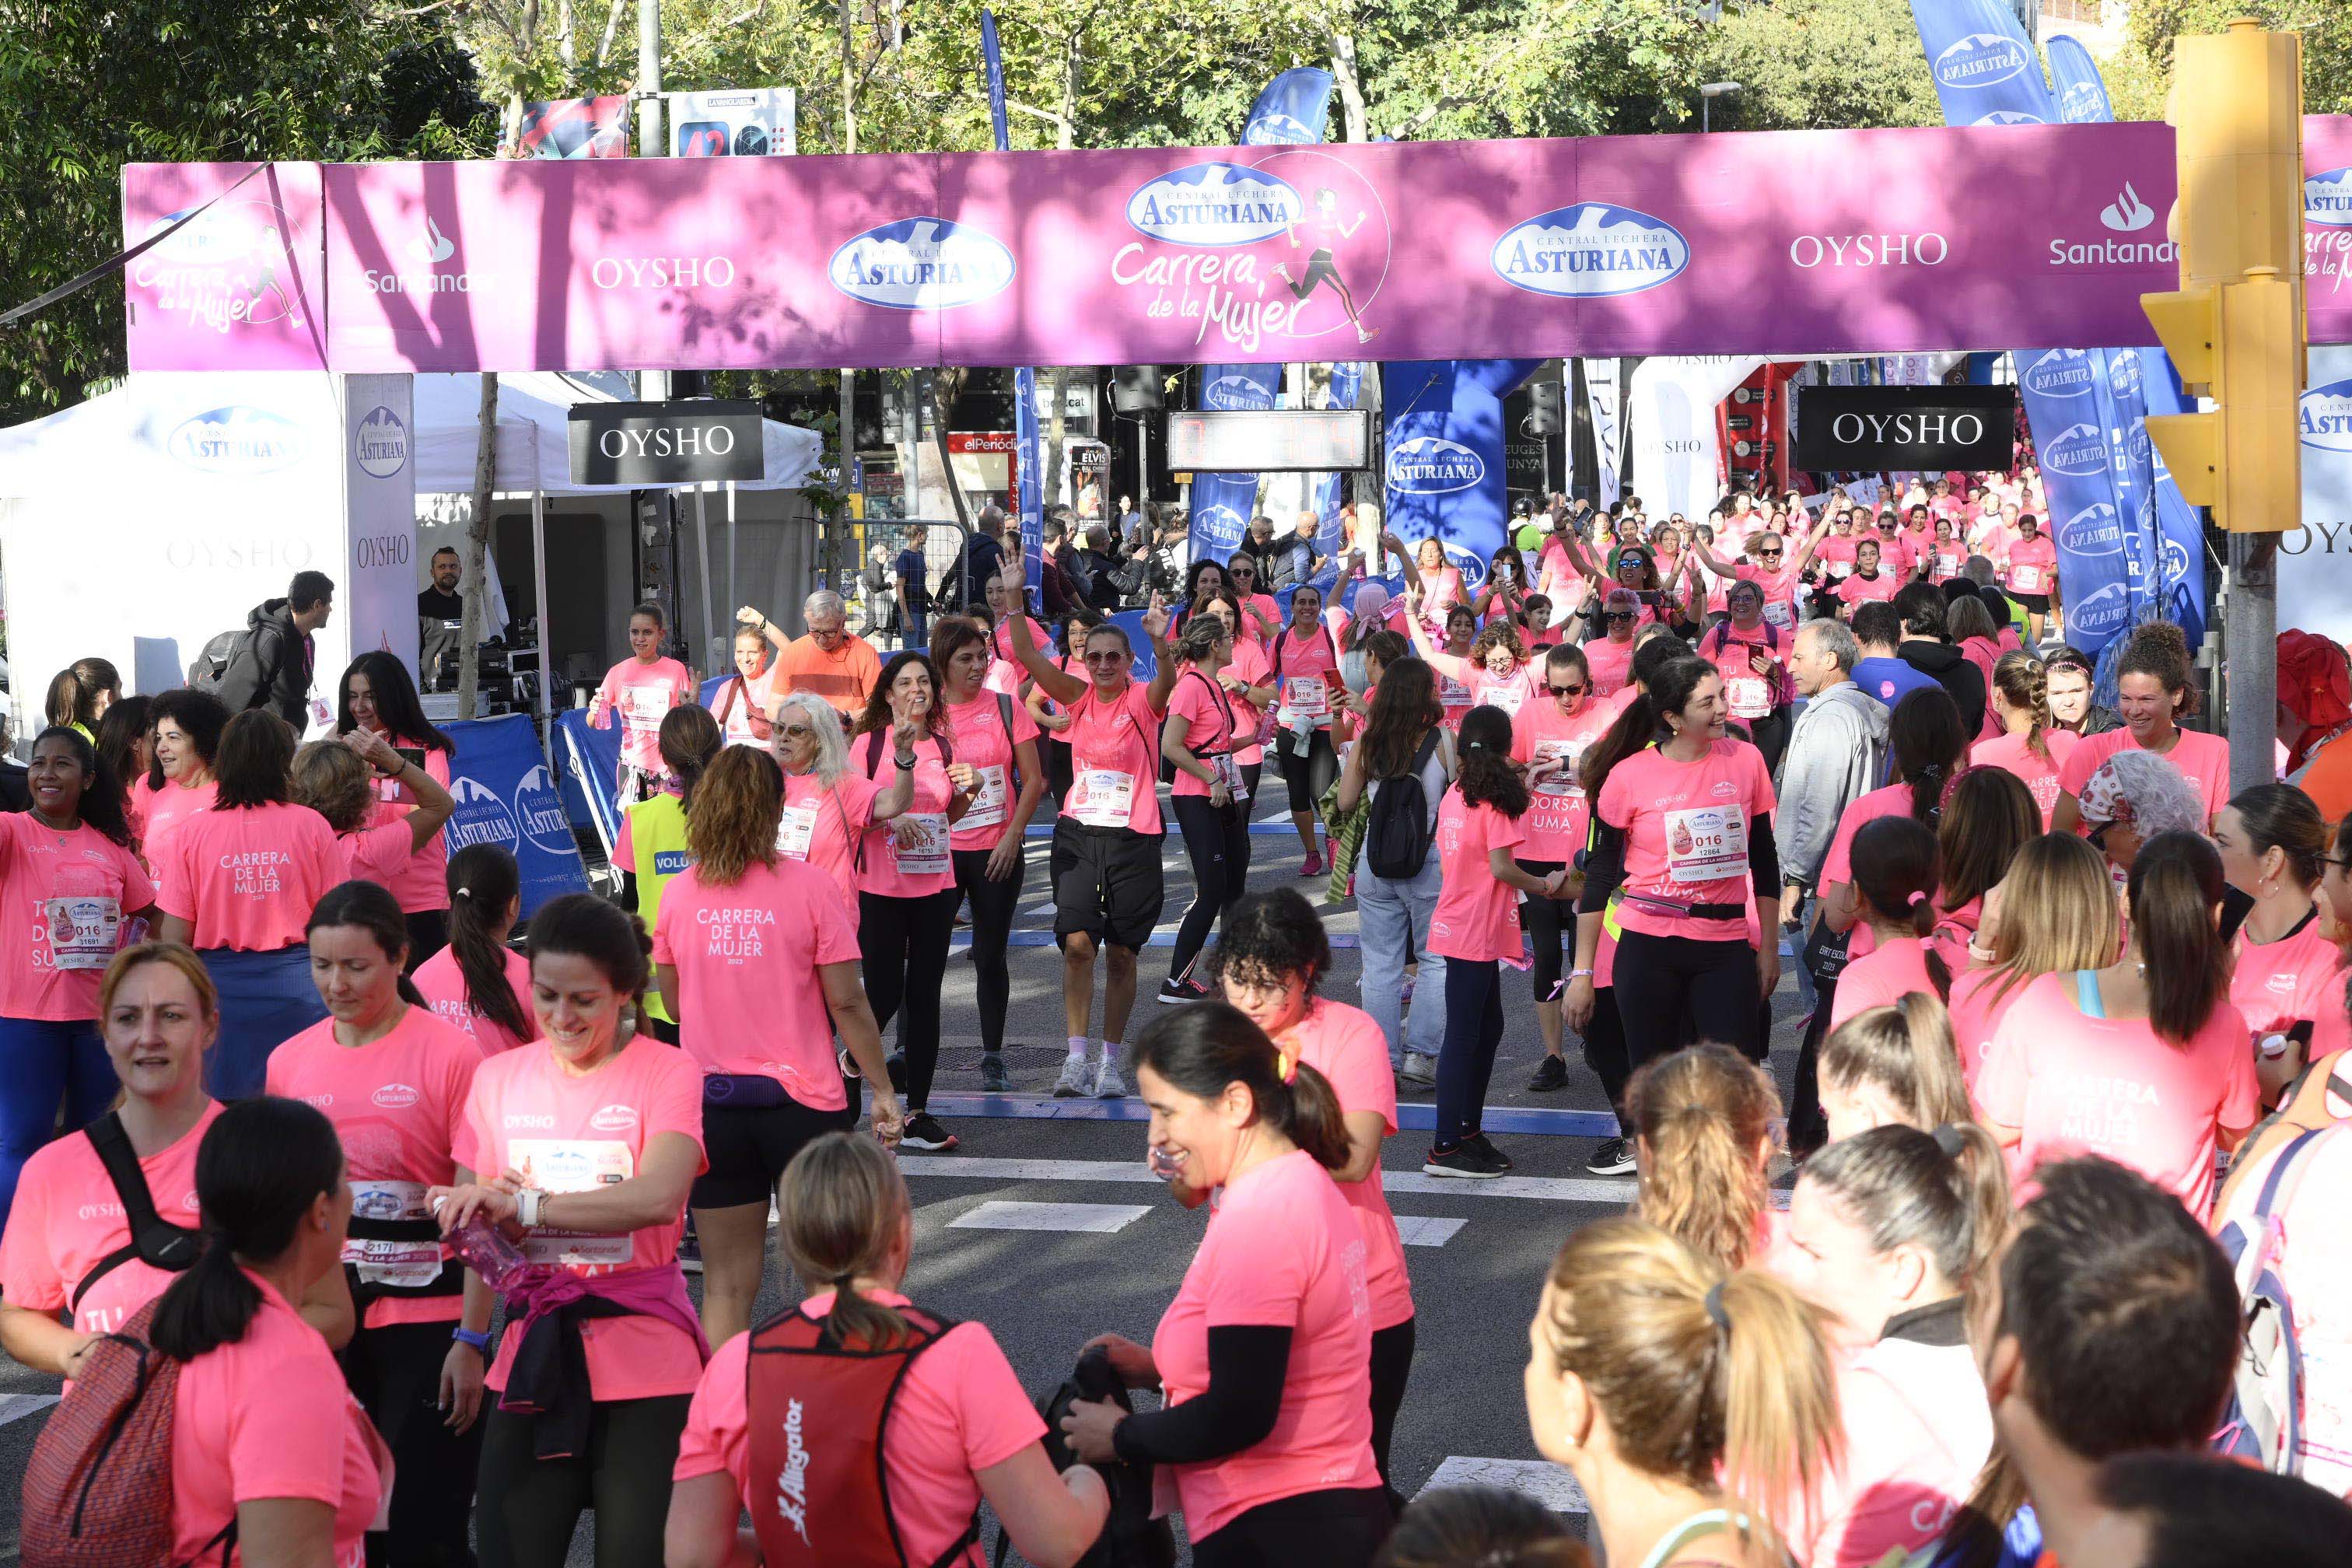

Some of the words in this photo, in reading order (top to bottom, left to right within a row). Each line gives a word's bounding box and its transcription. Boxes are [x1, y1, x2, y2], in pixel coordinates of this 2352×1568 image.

[1167, 190, 1222, 200] CENTRAL
[1227, 189, 1284, 199] LECHERA
[1139, 194, 1289, 226] ASTURIANA
[1537, 236, 1598, 246] CENTRAL
[1605, 235, 1668, 244] LECHERA
[1506, 239, 1675, 275] ASTURIANA
[1789, 232, 1948, 268] OYSHO
[1111, 241, 1258, 286] Carrera
[2322, 254, 2336, 276] la
[591, 256, 735, 289] OYSHO
[1146, 286, 1175, 318] de
[1180, 285, 1200, 317] la
[1195, 278, 1313, 353] Mujer
[1832, 412, 1983, 445] OYSHO
[359, 432, 404, 461] ASTURIANA
[599, 425, 735, 460] OYSHO
[1082, 452, 1106, 463] ELVIS
[1389, 460, 1478, 482] ASTURIANA
[357, 534, 409, 569] OYSHO
[1655, 793, 1687, 807] OYSHO
[450, 817, 516, 849] ASTURIANA
[1695, 835, 1722, 847] 016
[219, 851, 291, 869] CARRERA
[235, 866, 254, 881] DE
[258, 866, 278, 879] LA
[1678, 869, 1703, 877] OYSHO
[234, 878, 281, 894] MUJER
[72, 908, 101, 917] ASTURIANA
[696, 908, 775, 925] CARRERA
[75, 925, 100, 936] 016
[711, 924, 732, 940] DE
[740, 925, 760, 941] LA
[708, 940, 763, 957] MUJER
[376, 1092, 415, 1103] ASTURIANA
[504, 1115, 555, 1129] OYSHO
[580, 1244, 622, 1255] Santander
